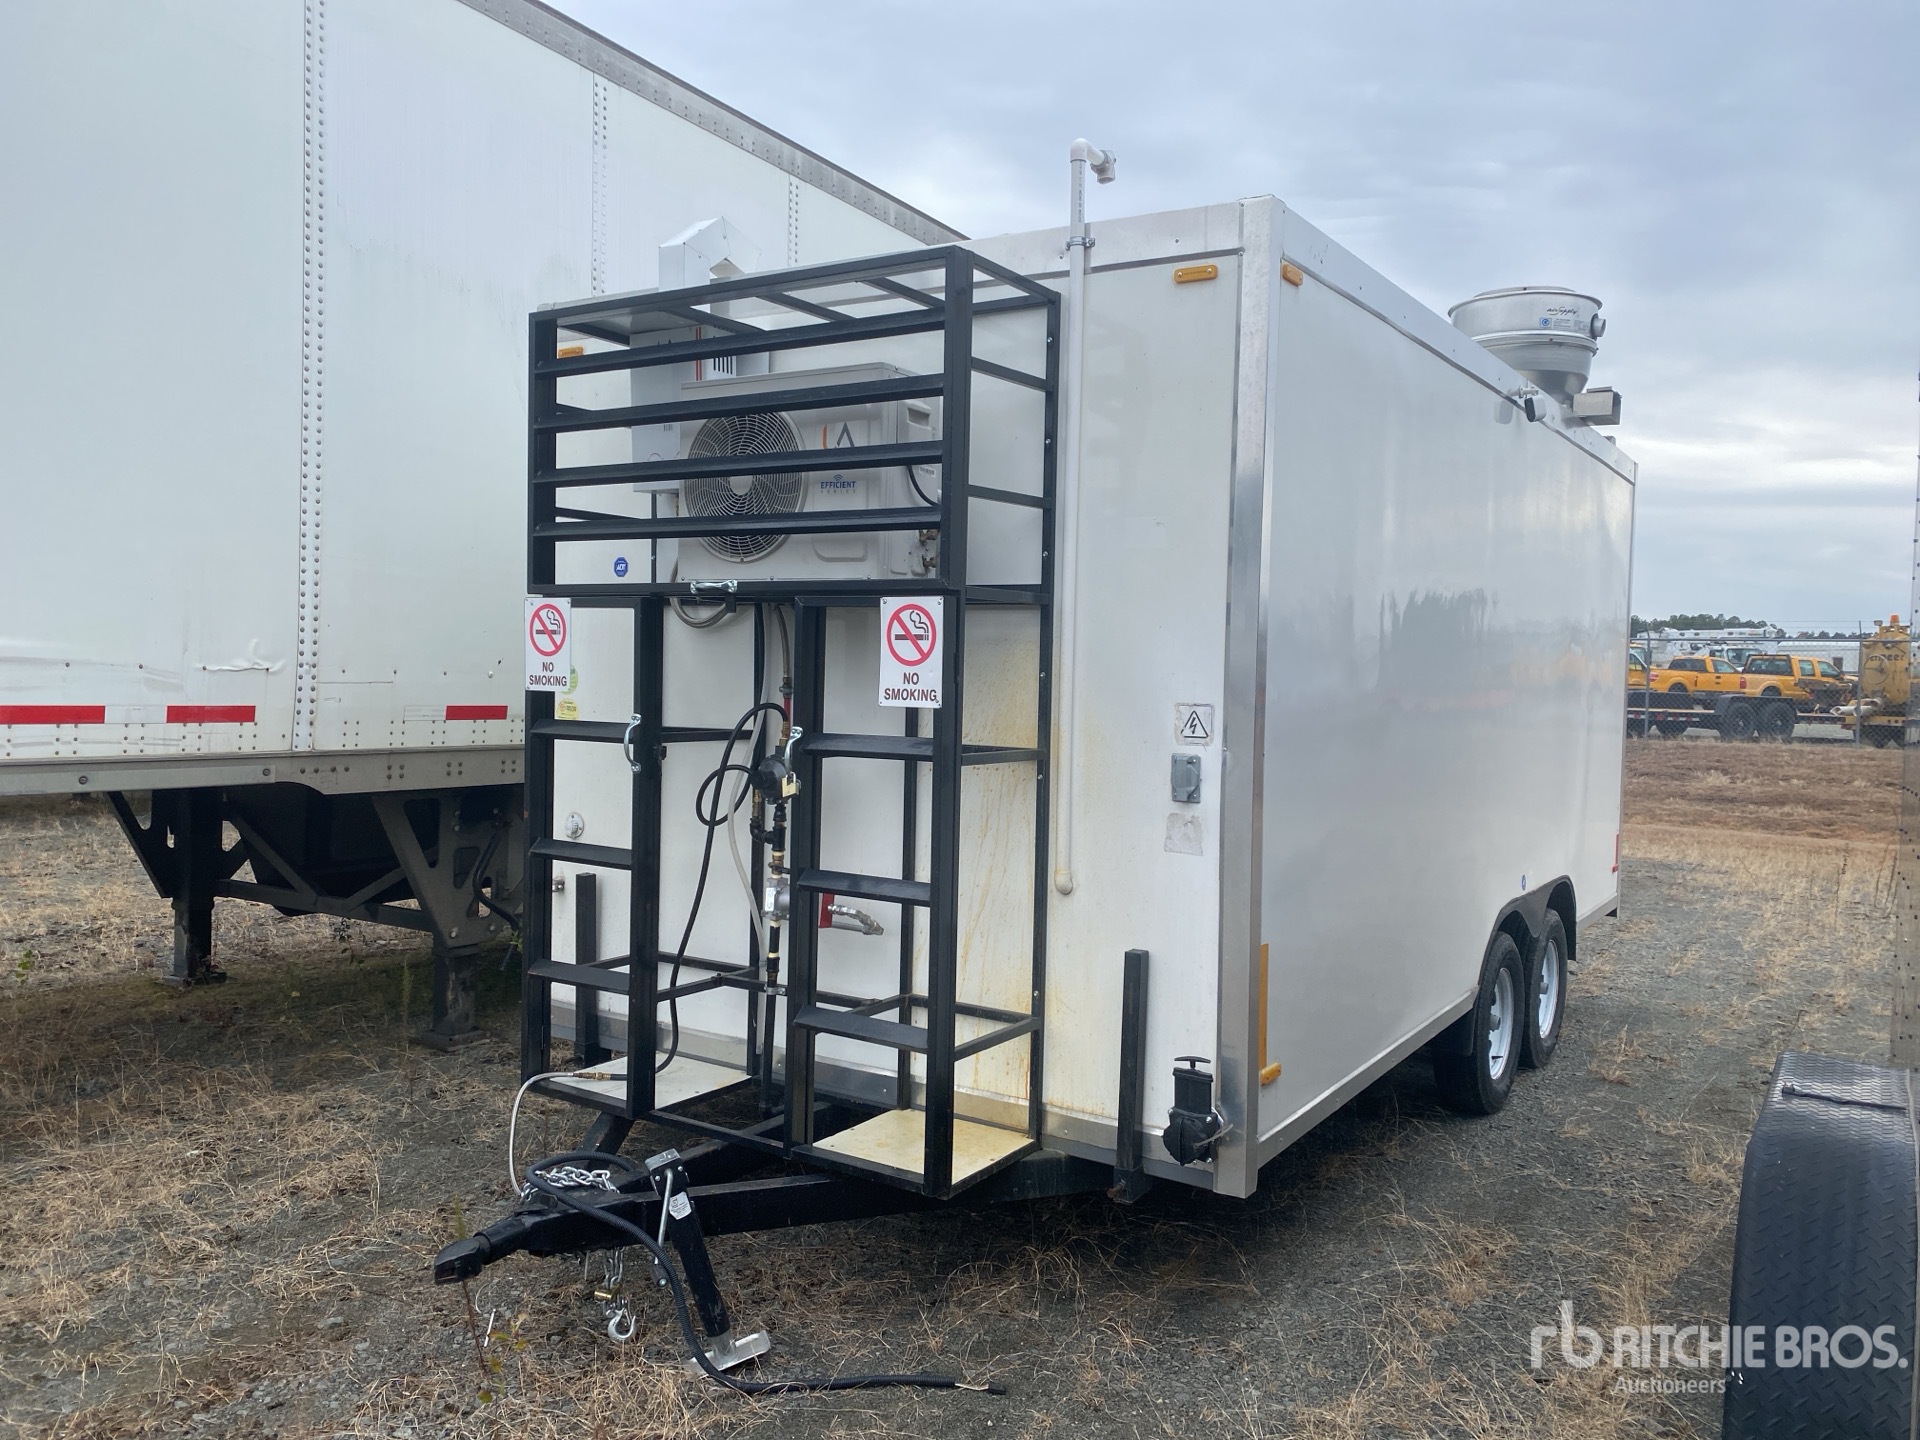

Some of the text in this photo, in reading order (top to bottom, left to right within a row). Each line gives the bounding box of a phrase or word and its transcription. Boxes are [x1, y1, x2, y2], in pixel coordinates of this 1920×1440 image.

[820, 481, 856, 489] EFFICIENT
[542, 661, 554, 673] NO
[529, 674, 568, 687] SMOKING
[903, 672, 919, 685] NO
[884, 687, 937, 702] SMOKING
